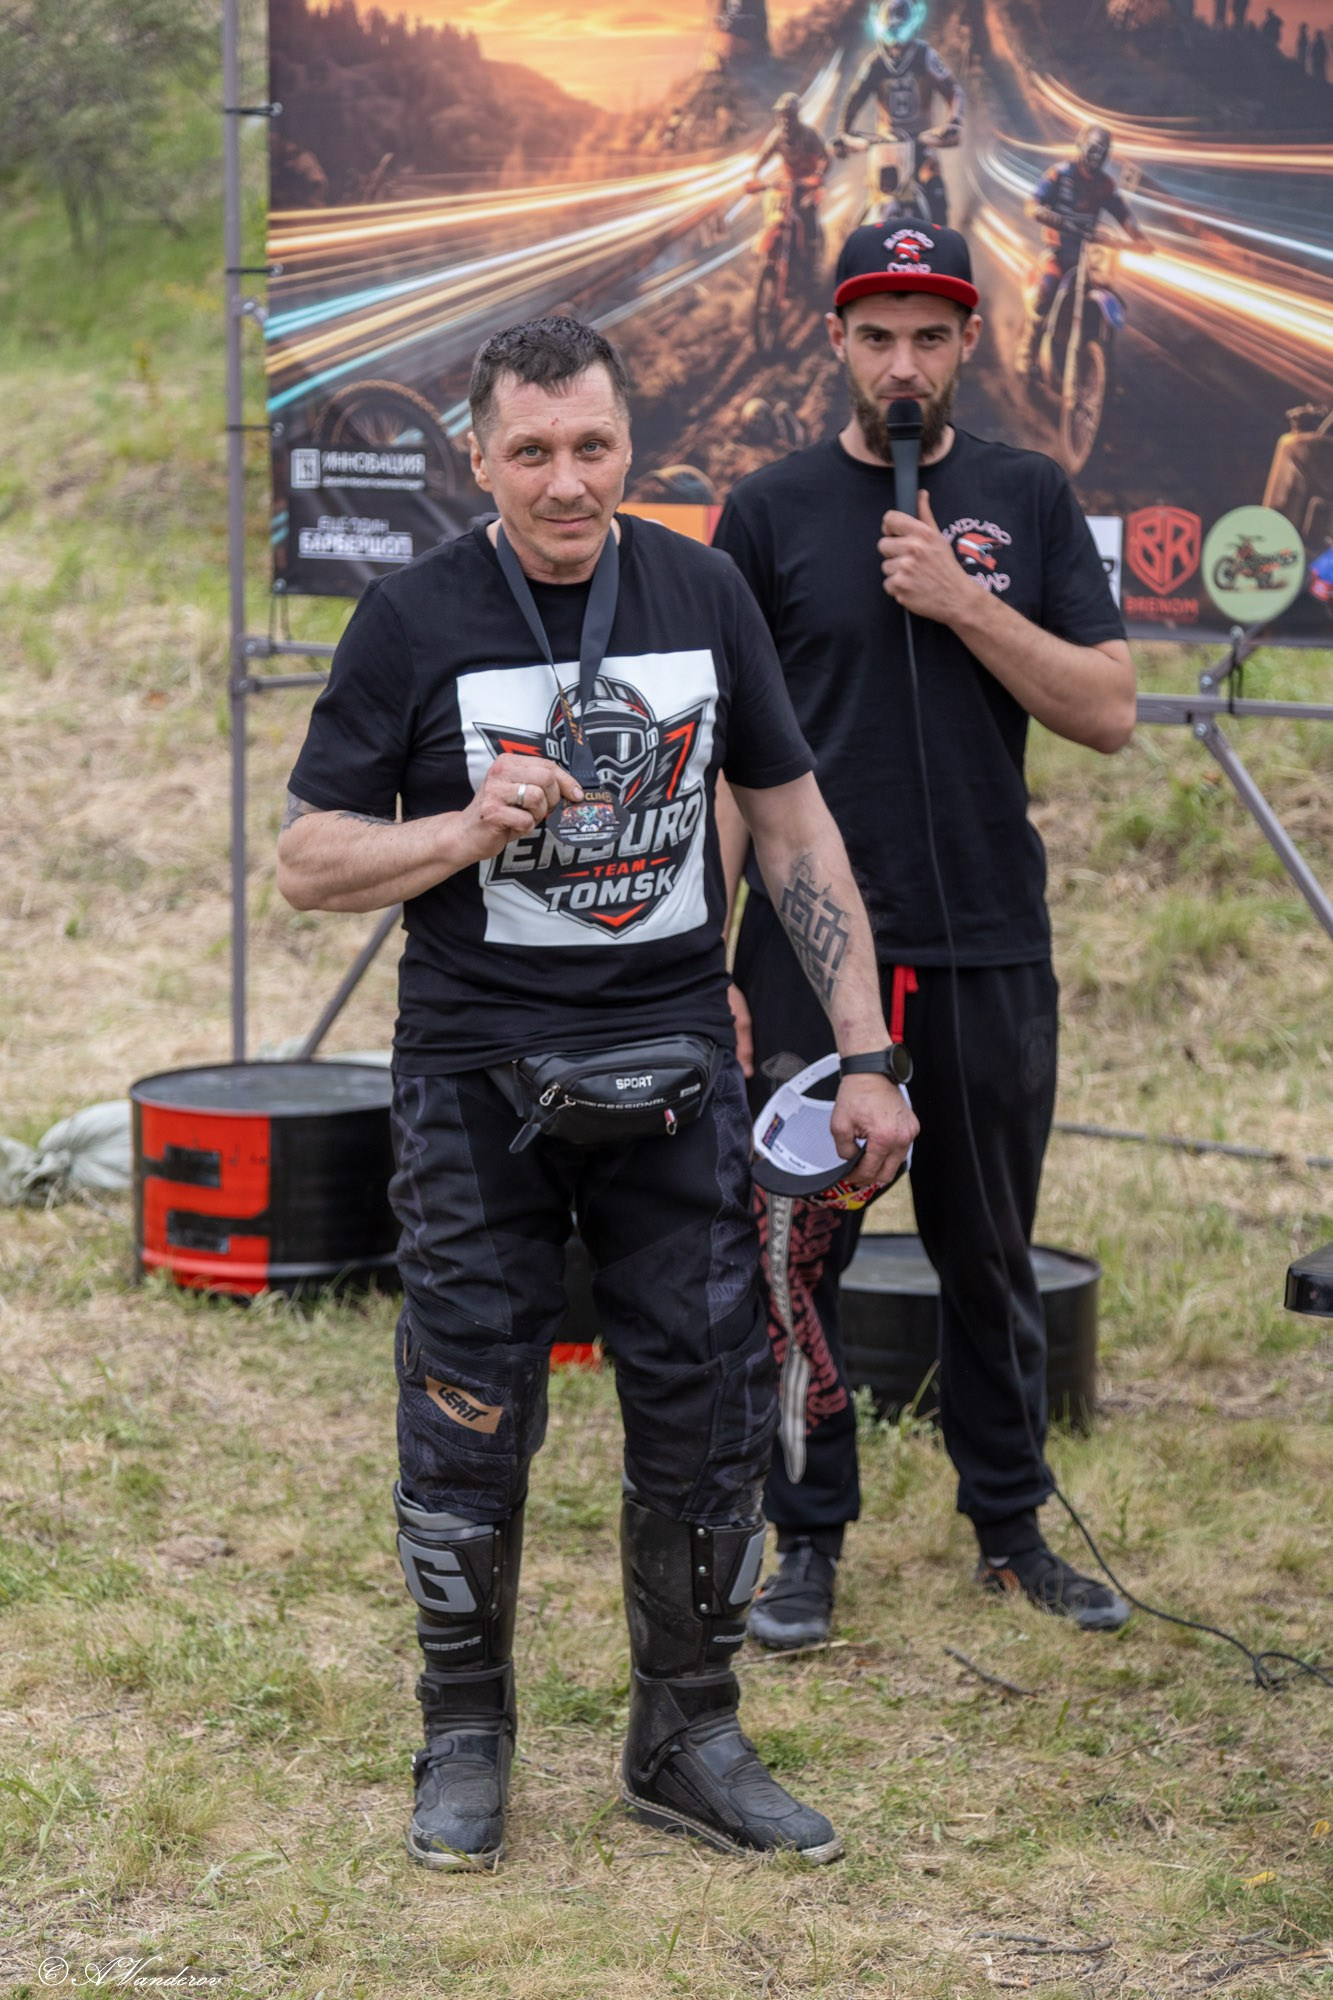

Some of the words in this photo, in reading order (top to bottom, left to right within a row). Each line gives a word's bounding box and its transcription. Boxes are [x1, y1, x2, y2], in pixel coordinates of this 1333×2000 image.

[321, 451, 426, 475] ИННОВАЦИЯ
[593, 859, 646, 878] TEAM
[545, 864, 677, 912] TOMSK
[616, 1075, 653, 1090] SPORT
